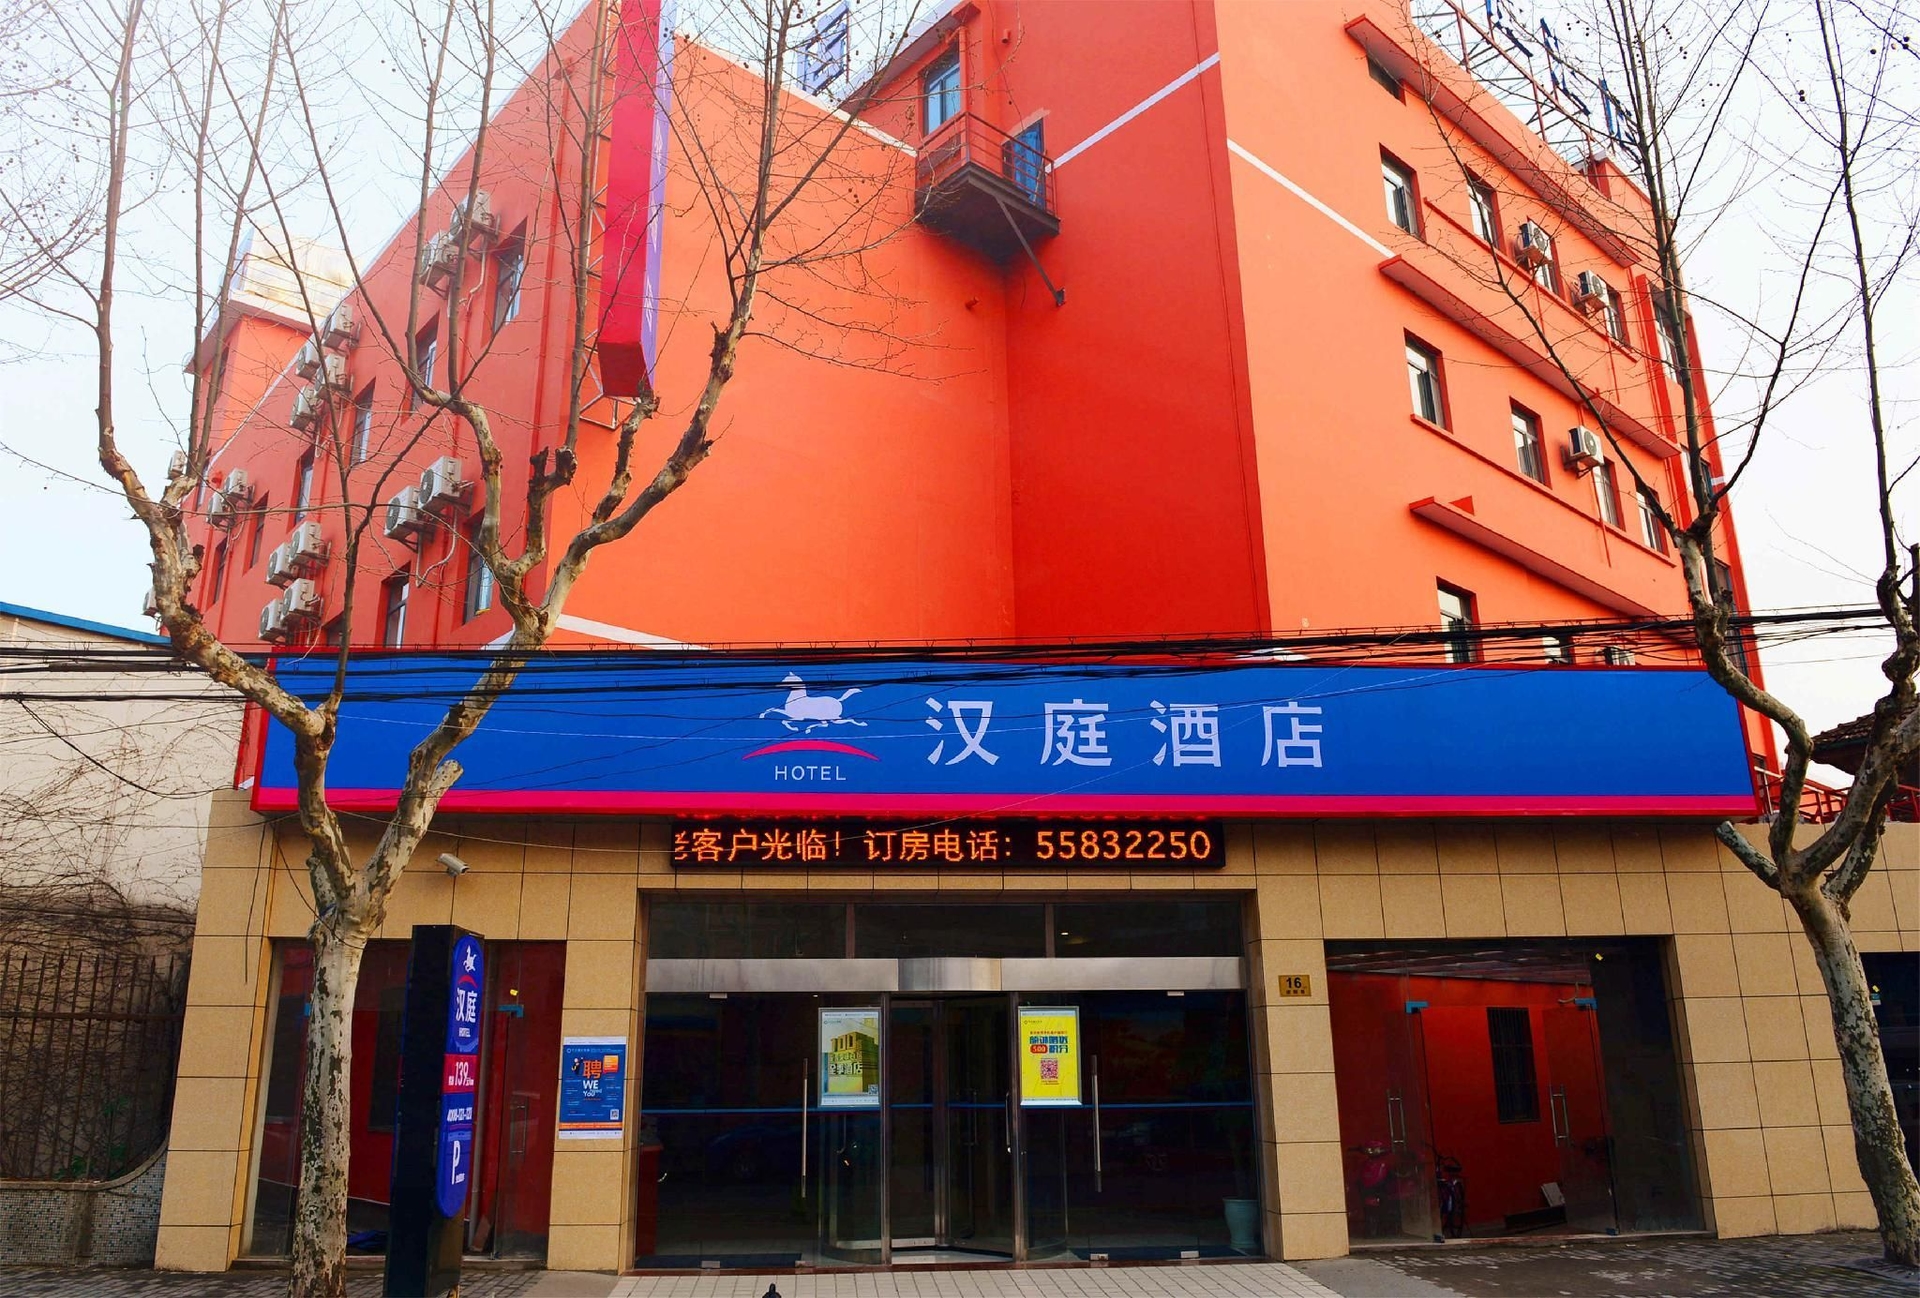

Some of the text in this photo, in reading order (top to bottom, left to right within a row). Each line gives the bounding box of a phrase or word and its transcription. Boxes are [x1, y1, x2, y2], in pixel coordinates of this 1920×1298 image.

[925, 698, 1324, 768] 汉庭酒店
[774, 765, 847, 781] HOTEL
[1036, 830, 1212, 860] 55832250
[1286, 977, 1302, 989] 16
[455, 987, 478, 1024] 汉庭
[583, 1060, 602, 1079] 聘
[583, 1080, 599, 1090] WE
[451, 1140, 461, 1185] P
